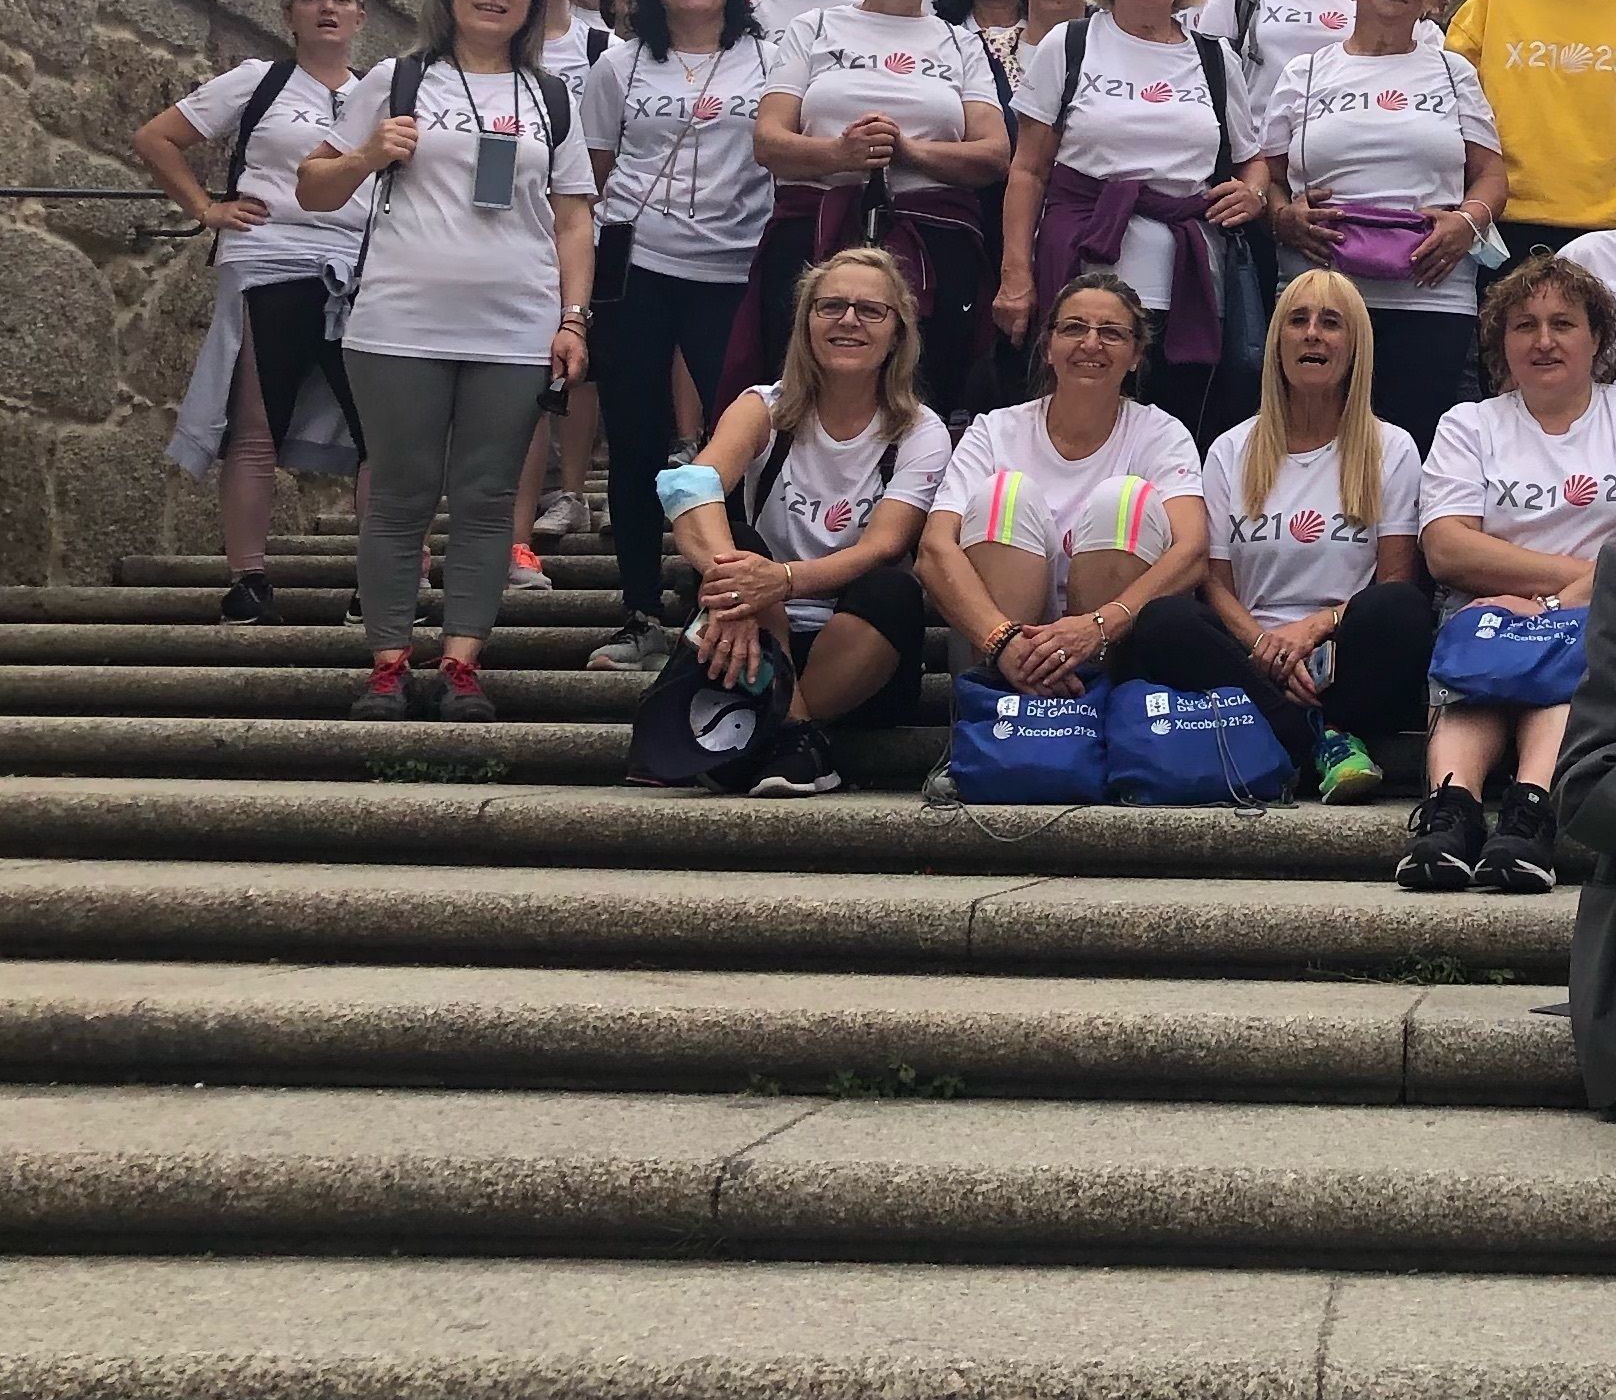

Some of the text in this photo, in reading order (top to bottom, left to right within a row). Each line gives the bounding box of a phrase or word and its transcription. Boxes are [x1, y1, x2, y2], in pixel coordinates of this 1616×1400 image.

[1262, 6, 1313, 24] X21
[828, 49, 953, 82] X21 22
[1505, 40, 1556, 73] X21
[1081, 72, 1134, 99] X21
[633, 95, 686, 119] X21
[1317, 92, 1447, 119] X21 22
[1496, 479, 1556, 511] X21
[1229, 513, 1283, 544] X21
[1026, 704, 1098, 719] DE GALICIA
[1174, 714, 1255, 730] Xacobeo 21-22
[1017, 725, 1073, 737] Xacobeo
